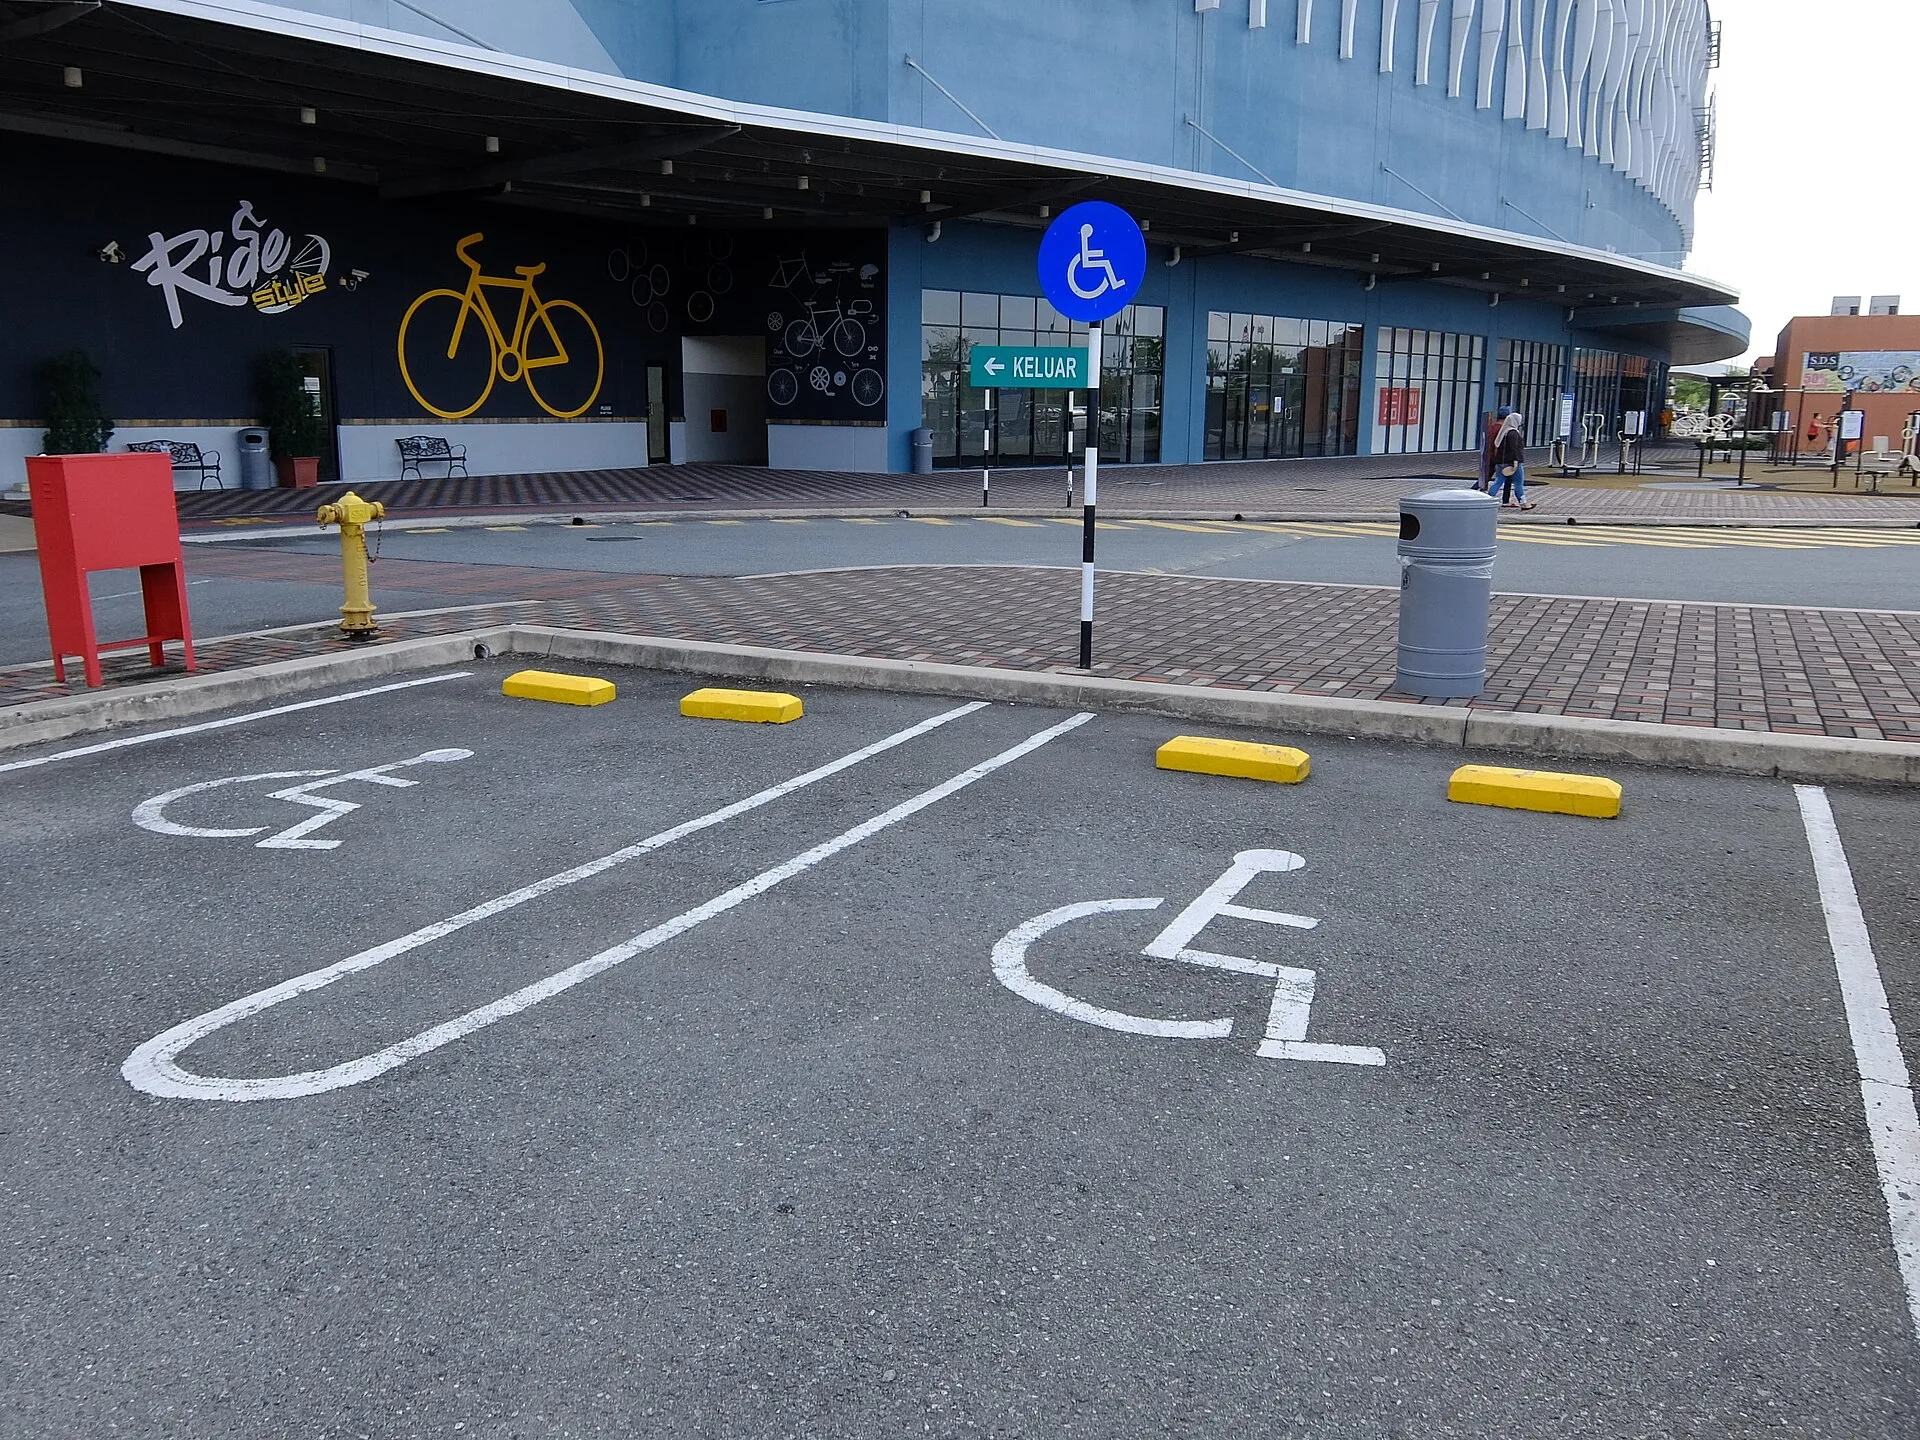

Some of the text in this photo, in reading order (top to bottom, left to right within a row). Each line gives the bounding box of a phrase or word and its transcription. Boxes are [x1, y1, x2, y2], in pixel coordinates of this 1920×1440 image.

[130, 200, 291, 329] Ride
[252, 271, 327, 309] style
[1013, 356, 1077, 378] KELUAR
